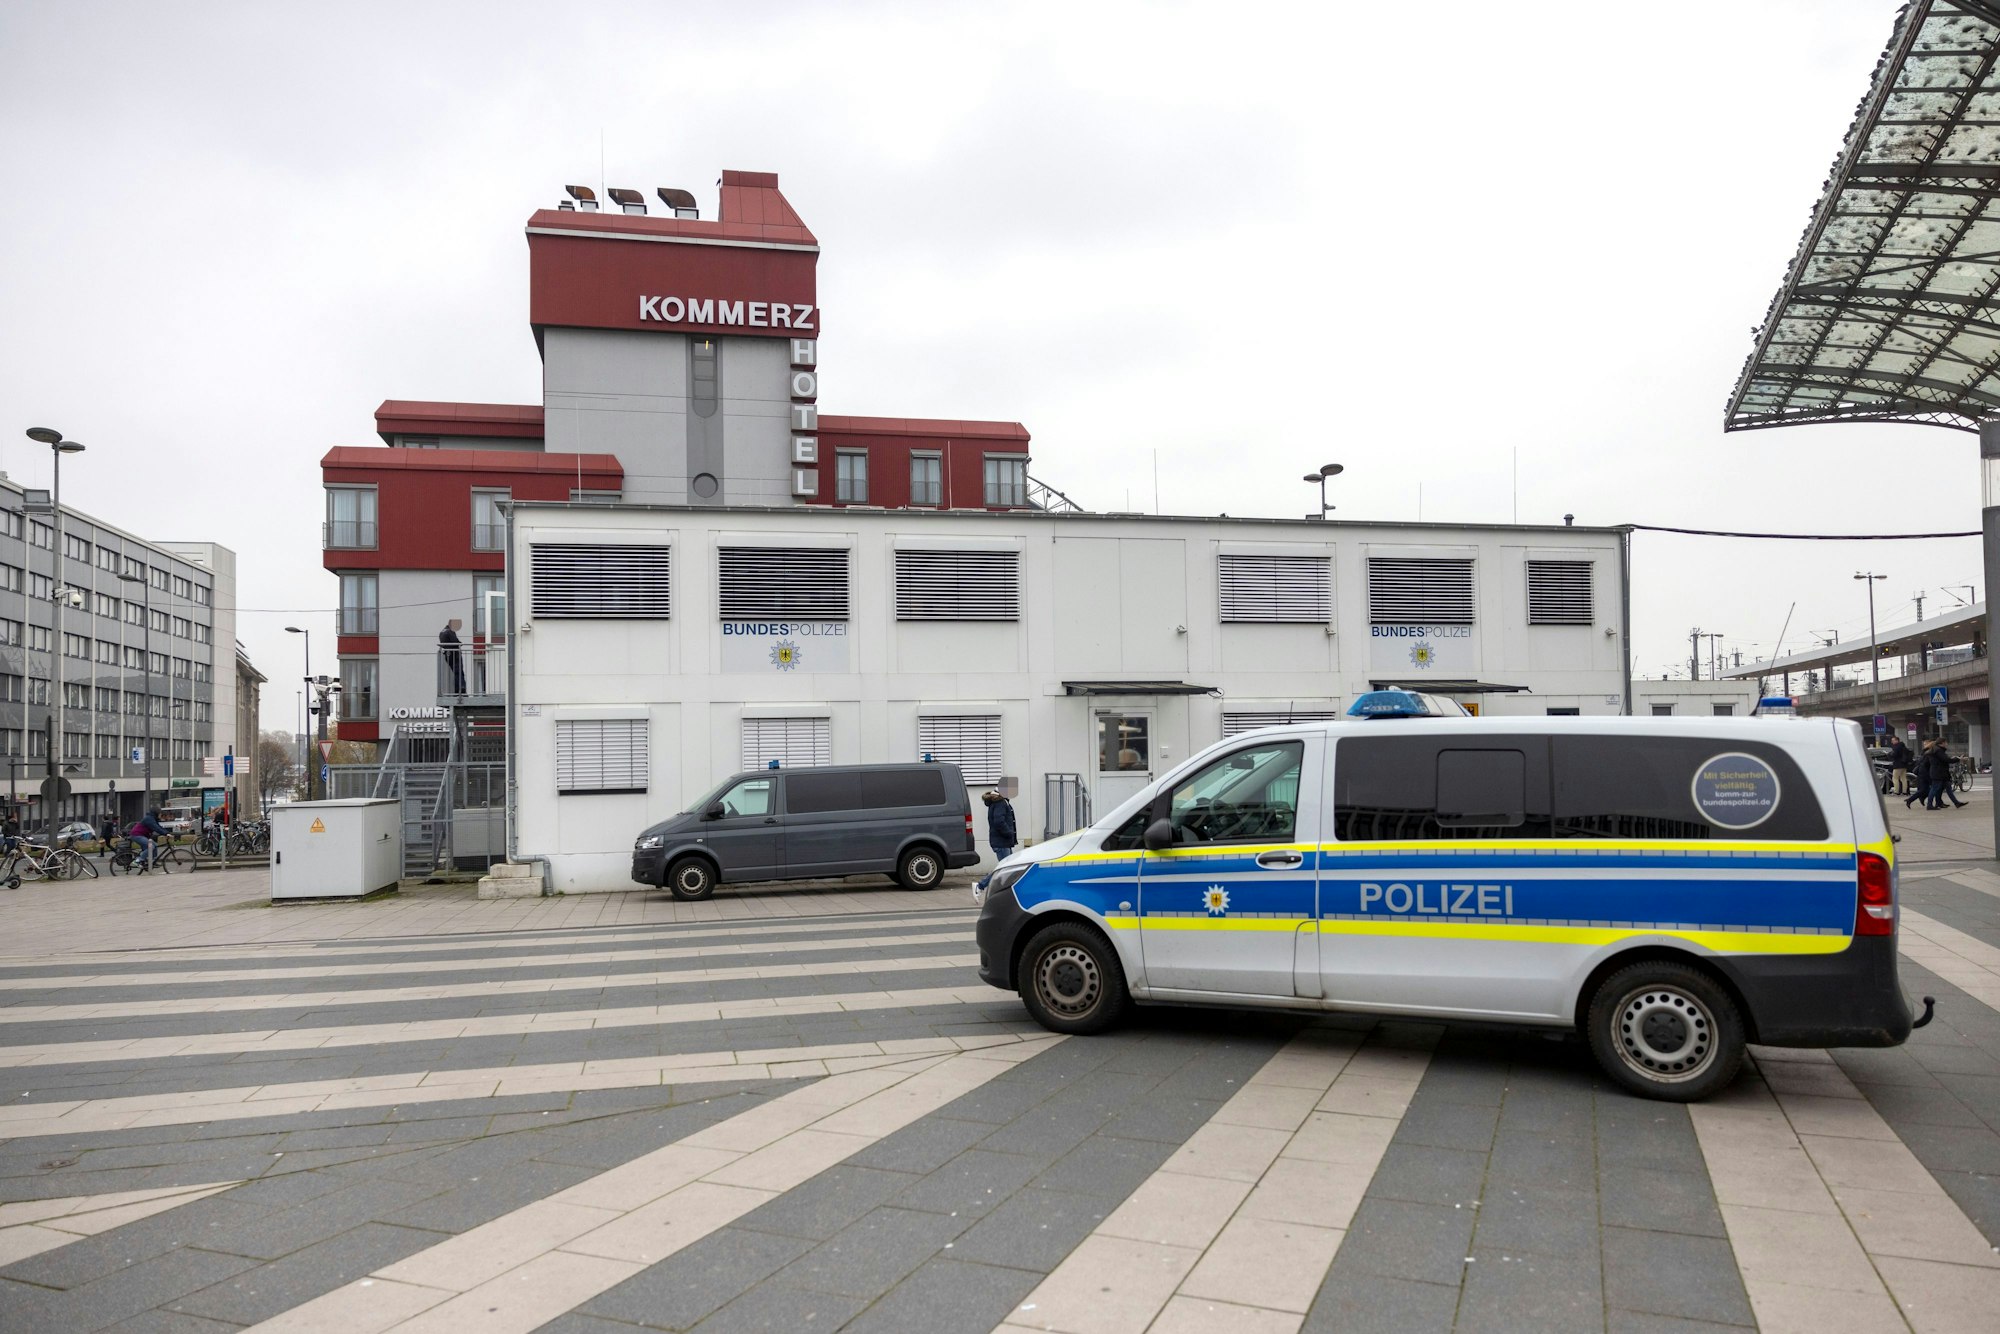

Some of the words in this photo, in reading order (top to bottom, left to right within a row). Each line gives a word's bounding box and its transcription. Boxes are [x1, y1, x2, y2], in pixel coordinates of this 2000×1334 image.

[639, 295, 814, 329] KOMMERZ
[791, 339, 816, 495] HOTEL
[723, 623, 847, 636] BUNDESPOLIZEI
[1371, 626, 1471, 638] BUNDESPOLIZEI
[388, 707, 451, 719] KOMMER
[1703, 771, 1717, 780] Mit
[1720, 771, 1768, 780] Sicherheit
[1702, 799, 1771, 807] bundespolizei.de
[1360, 883, 1513, 915] POLIZEI
